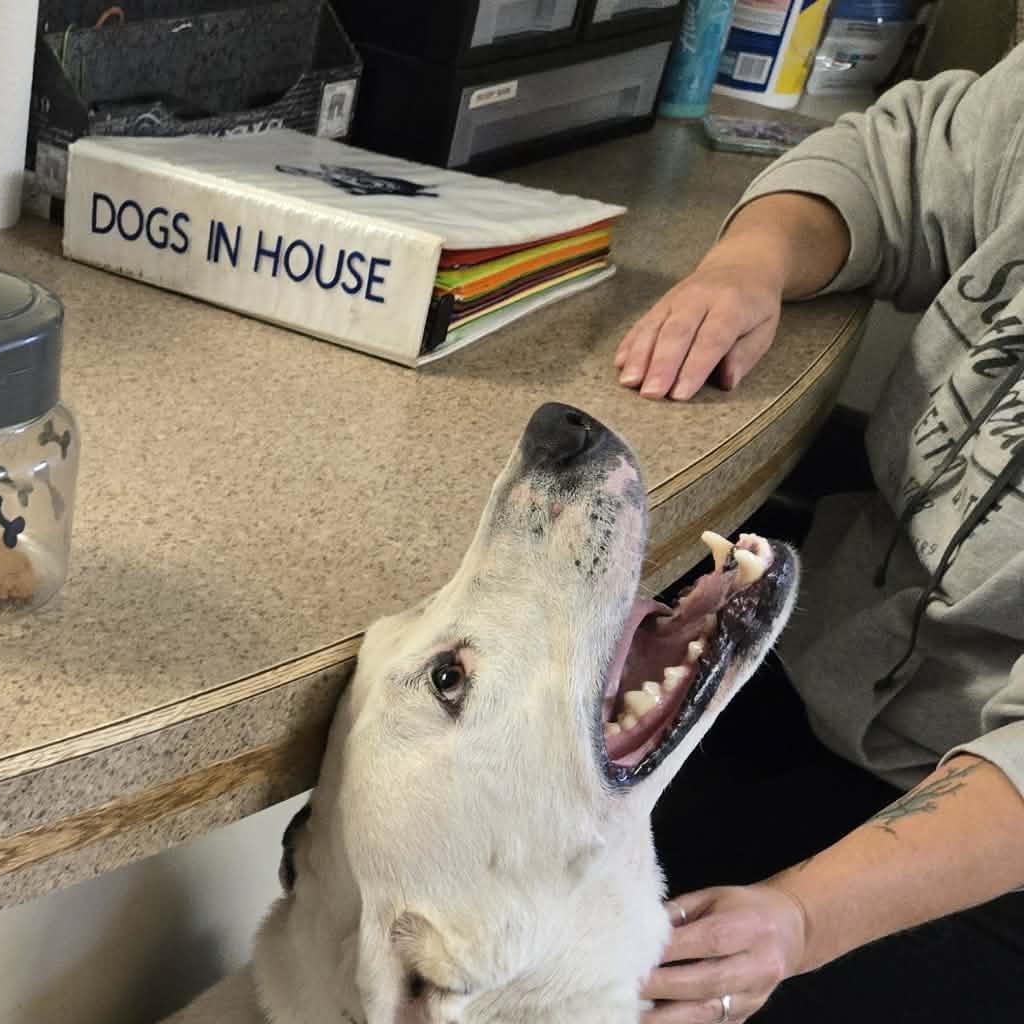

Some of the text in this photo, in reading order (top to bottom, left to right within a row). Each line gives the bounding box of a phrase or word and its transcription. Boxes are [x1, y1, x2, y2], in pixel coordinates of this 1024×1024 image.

[91, 192, 392, 303] DOGS IN HOUSE
